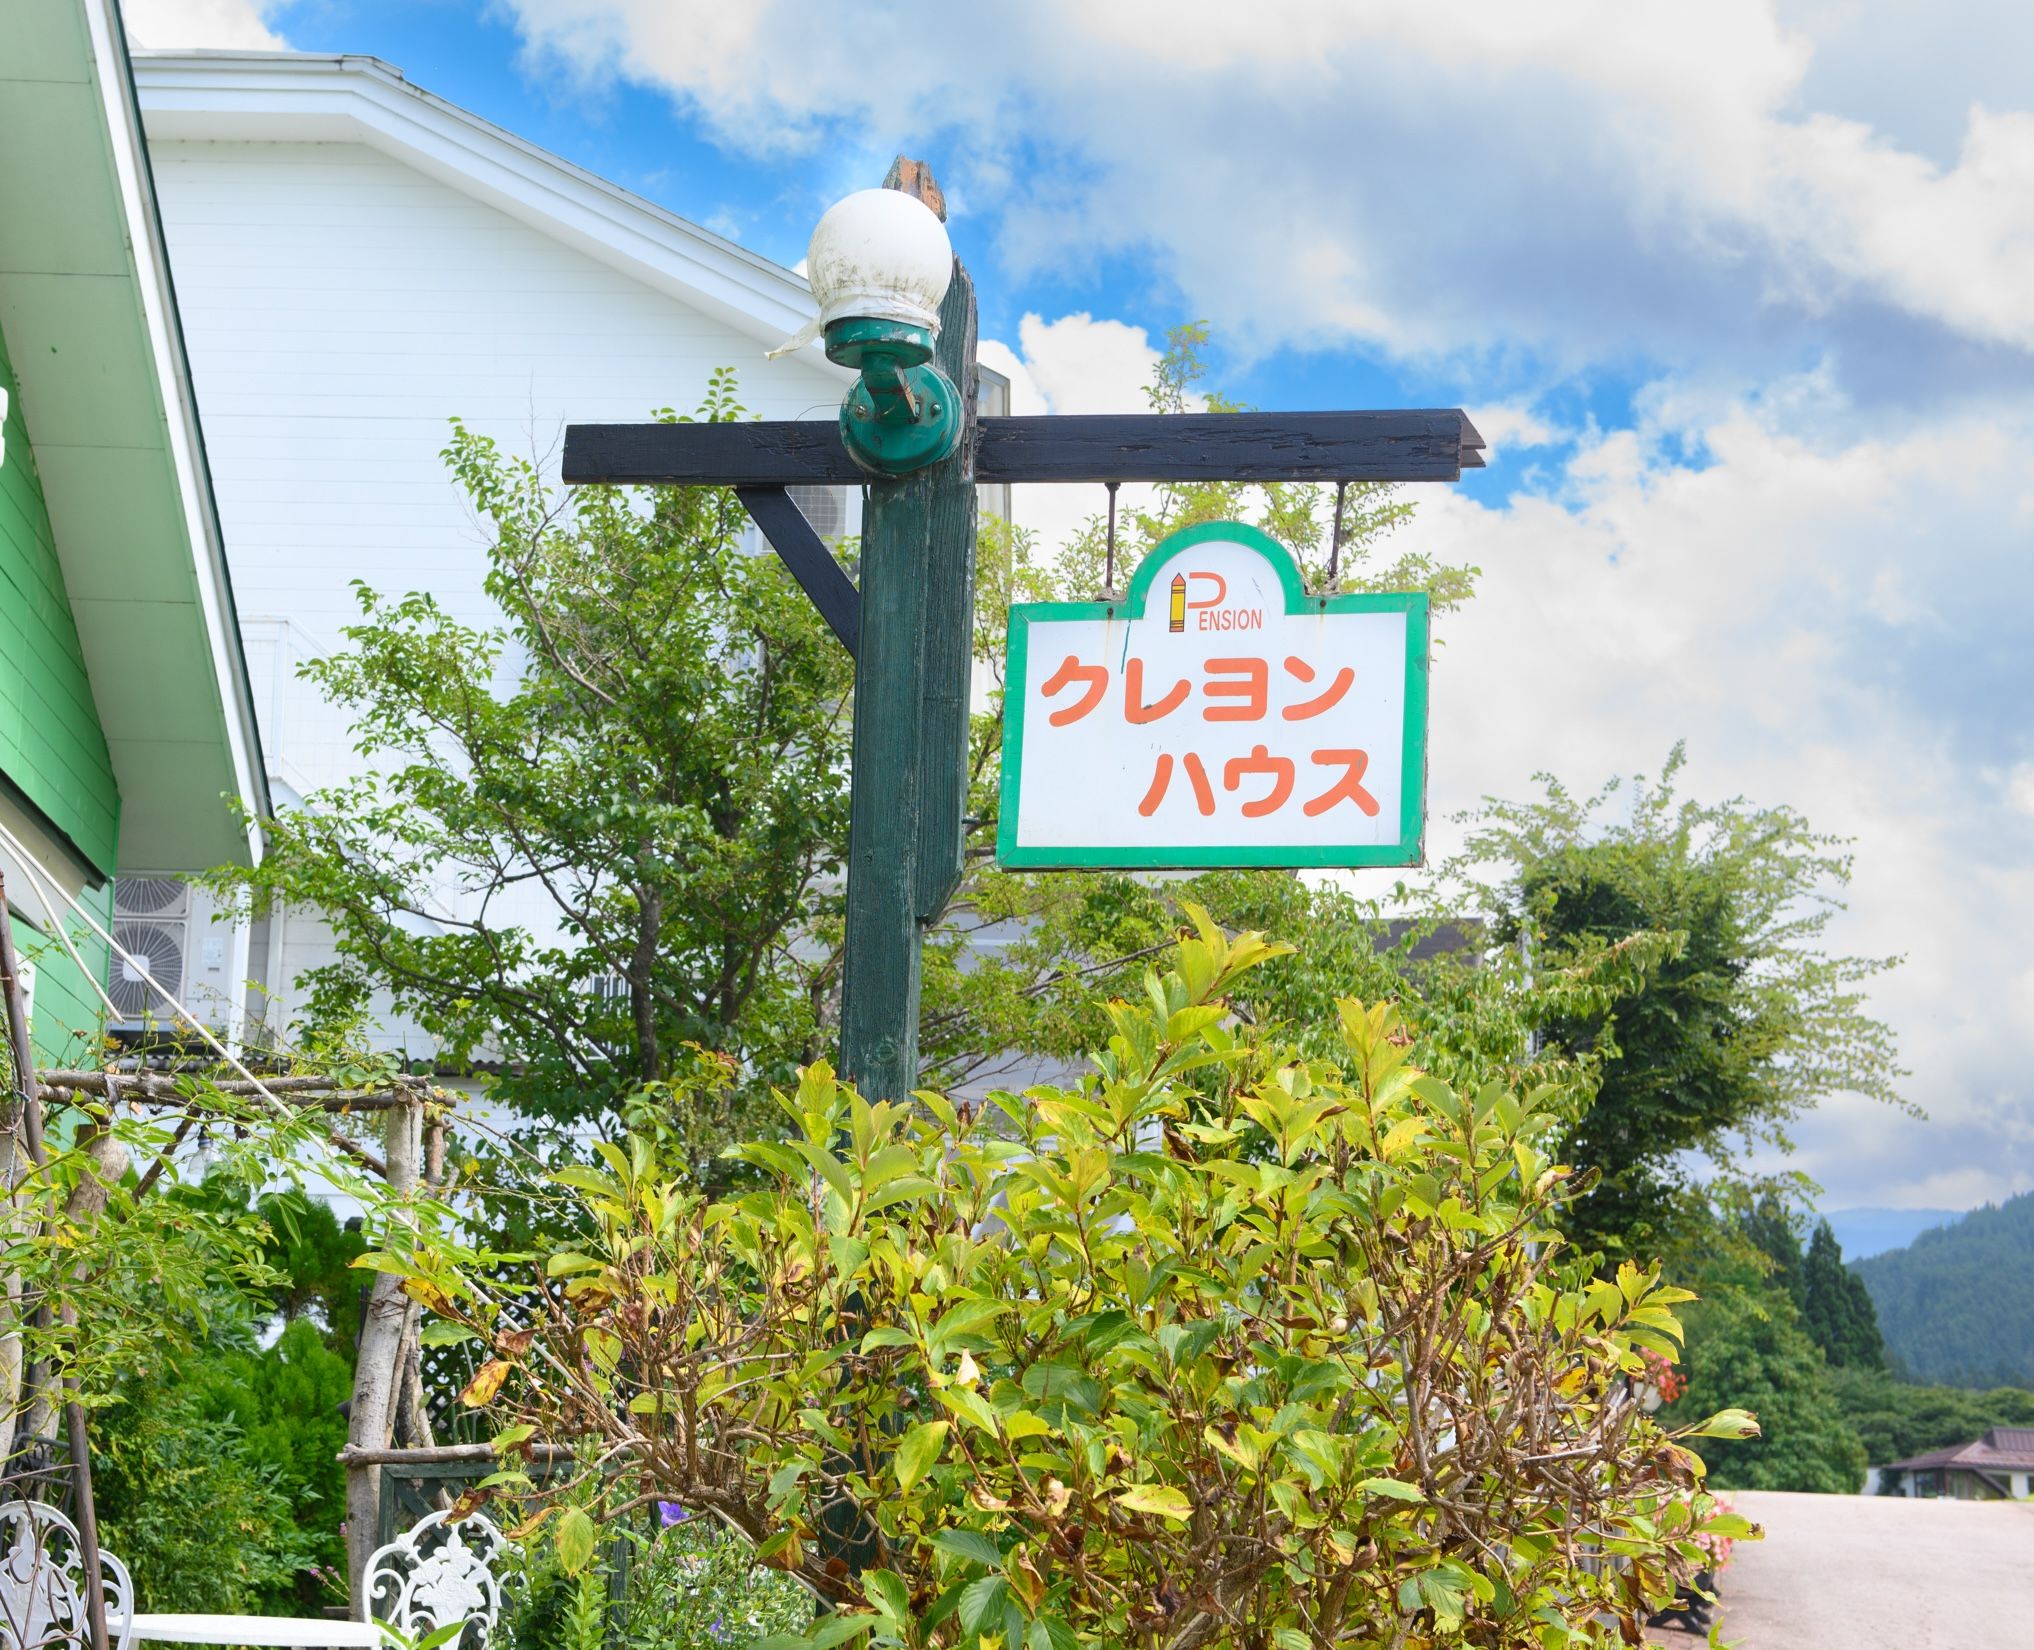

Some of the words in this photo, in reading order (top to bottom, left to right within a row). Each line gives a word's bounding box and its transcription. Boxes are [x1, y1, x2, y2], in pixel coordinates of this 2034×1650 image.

[1169, 572, 1262, 632] PENSION
[1041, 655, 1355, 727] クレヨン
[1138, 744, 1380, 817] ハウス
